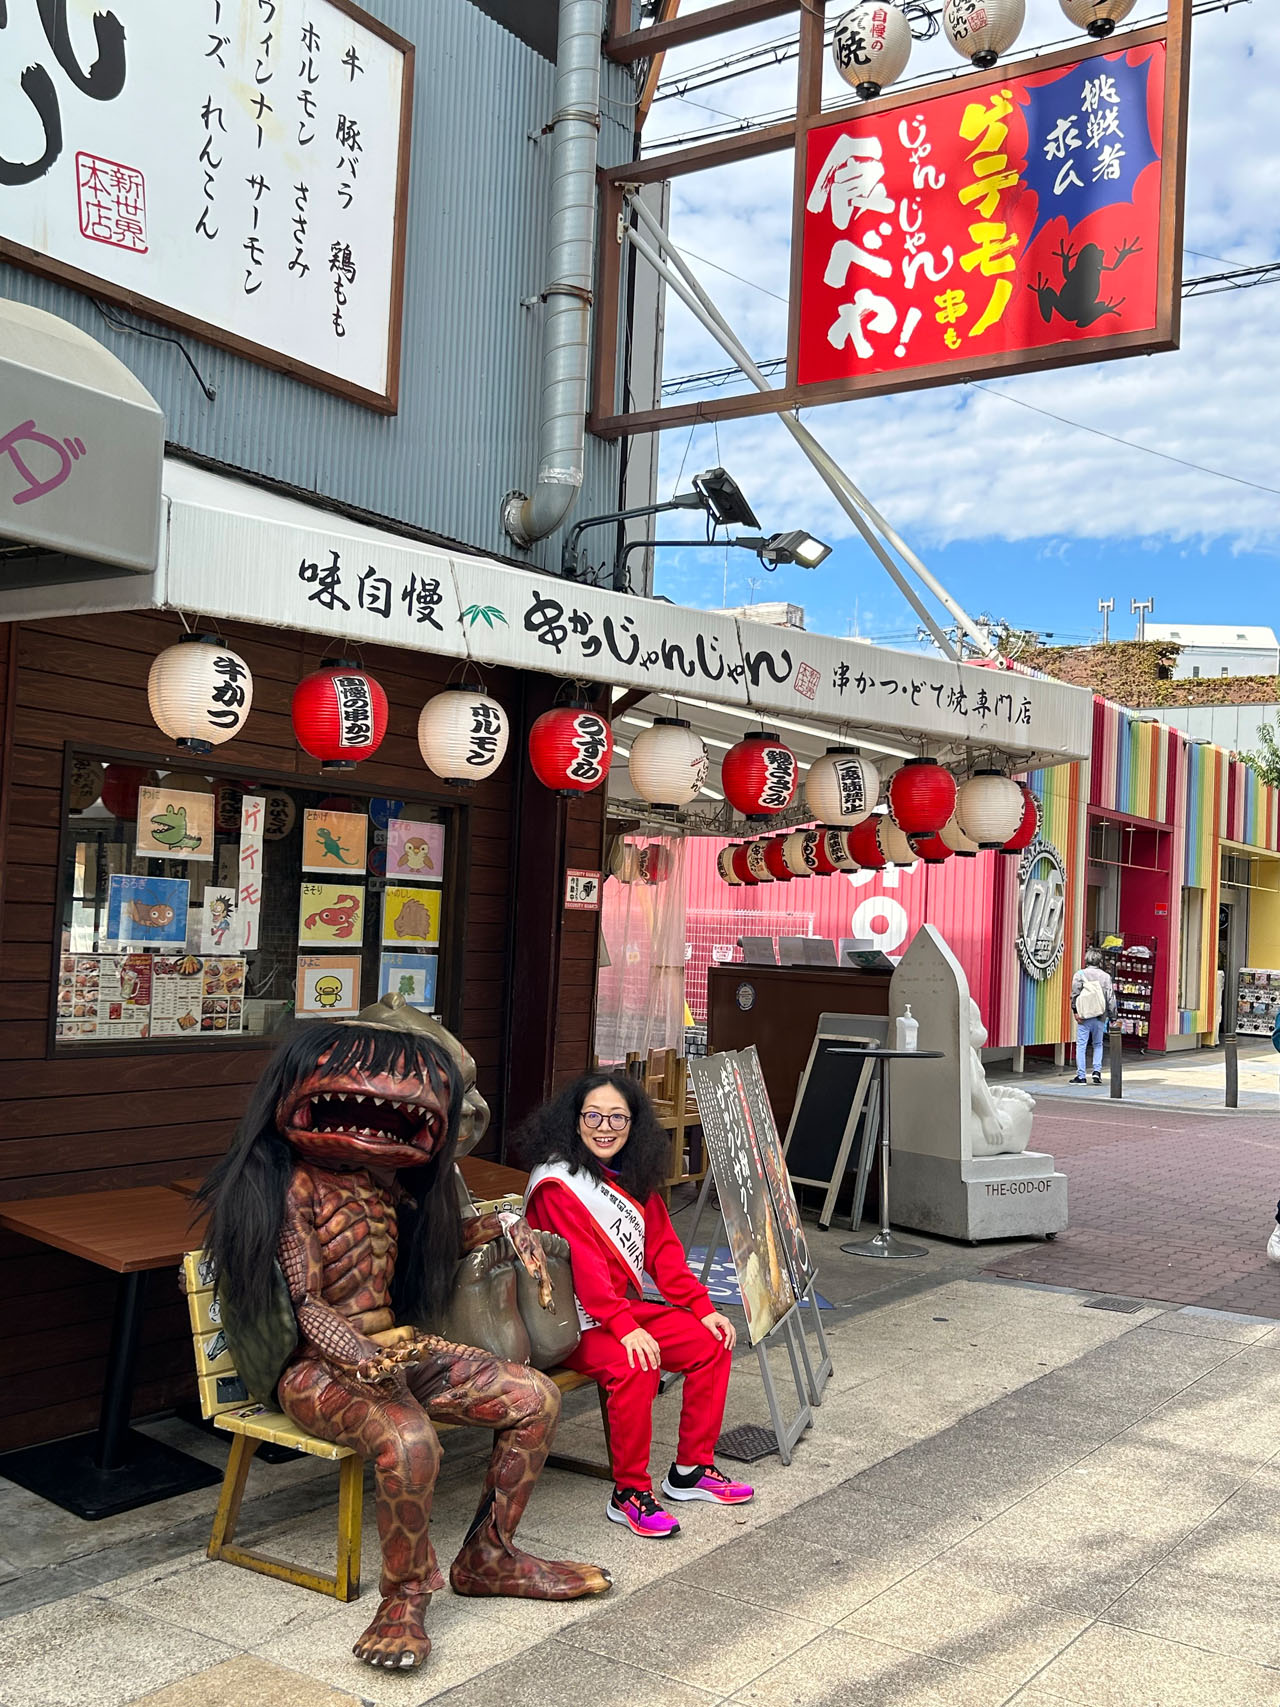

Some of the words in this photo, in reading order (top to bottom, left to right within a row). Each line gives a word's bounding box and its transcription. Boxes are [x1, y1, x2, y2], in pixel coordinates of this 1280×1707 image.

[341, 46, 365, 82] 牛
[870, 8, 888, 52] 自慢の
[296, 21, 321, 146] ホルモン
[195, 94, 228, 240] れんこん
[335, 113, 364, 209] 豚バラ
[1043, 115, 1085, 196] 求ム
[1081, 75, 1126, 182] 挑戦者
[80, 159, 113, 239] 本店
[109, 166, 146, 247] 新世界
[242, 173, 271, 294] サーモン
[288, 181, 311, 279] ささみ
[898, 114, 954, 290] じゃんじゃん
[959, 89, 1019, 338] ゲテモノ
[328, 240, 357, 337] 鶏もも
[933, 288, 968, 349] 串も
[297, 548, 444, 631] 味自慢
[523, 590, 793, 687] 串かつじゃんじゃん
[207, 656, 247, 728] 牛かつ
[339, 677, 371, 744] 自慢の串かつ
[466, 703, 501, 766] ホルモン
[571, 716, 605, 779] うずら
[142, 788, 161, 799] わに
[838, 760, 863, 813] 二度漬禁止
[241, 802, 262, 945] ゲテモノ
[303, 885, 323, 895] さそり
[300, 957, 321, 968] ひよこ
[985, 1180, 1052, 1197] THE-GOD-OF
